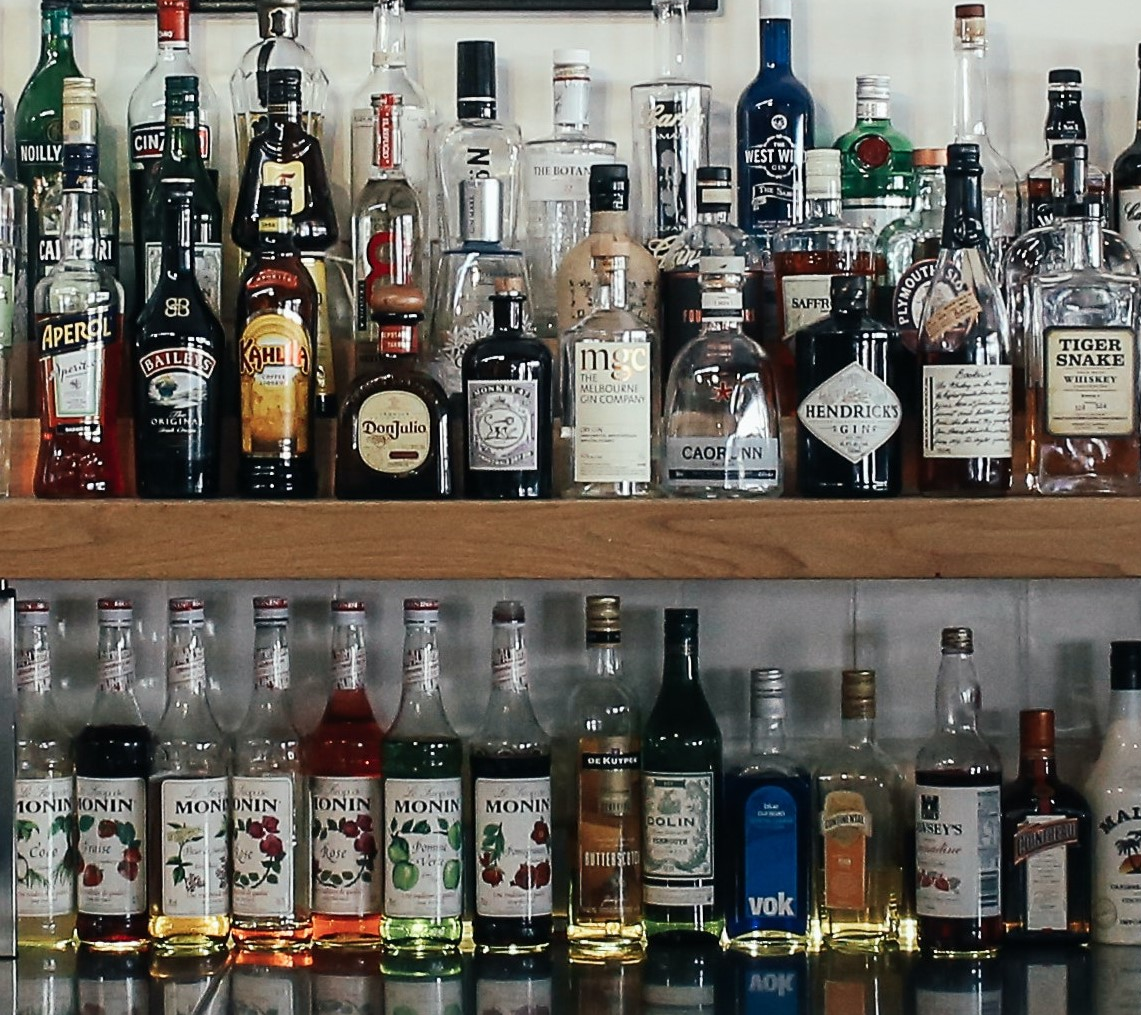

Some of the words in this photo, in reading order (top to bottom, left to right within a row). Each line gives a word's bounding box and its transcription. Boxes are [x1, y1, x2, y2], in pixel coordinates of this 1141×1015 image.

[21, 145, 63, 161] NOILLY
[745, 149, 775, 163] WEST
[42, 318, 112, 350] APEROL
[1058, 338, 1121, 352] TIGER
[239, 337, 310, 375] KAHLA
[1056, 353, 1125, 367] SNAKE
[581, 348, 647, 382] mgc
[581, 374, 597, 382] THE
[1064, 375, 1118, 383] WHISKEY
[581, 385, 638, 393] MELBOURNE
[580, 395, 597, 403] GIN
[600, 395, 645, 403] COMPANY
[806, 404, 899, 418] HENDRICK'S
[682, 446, 763, 460] CAORNN
[395, 799, 459, 813] MONIN
[486, 799, 549, 813] MONIN
[748, 891, 795, 916] vok
